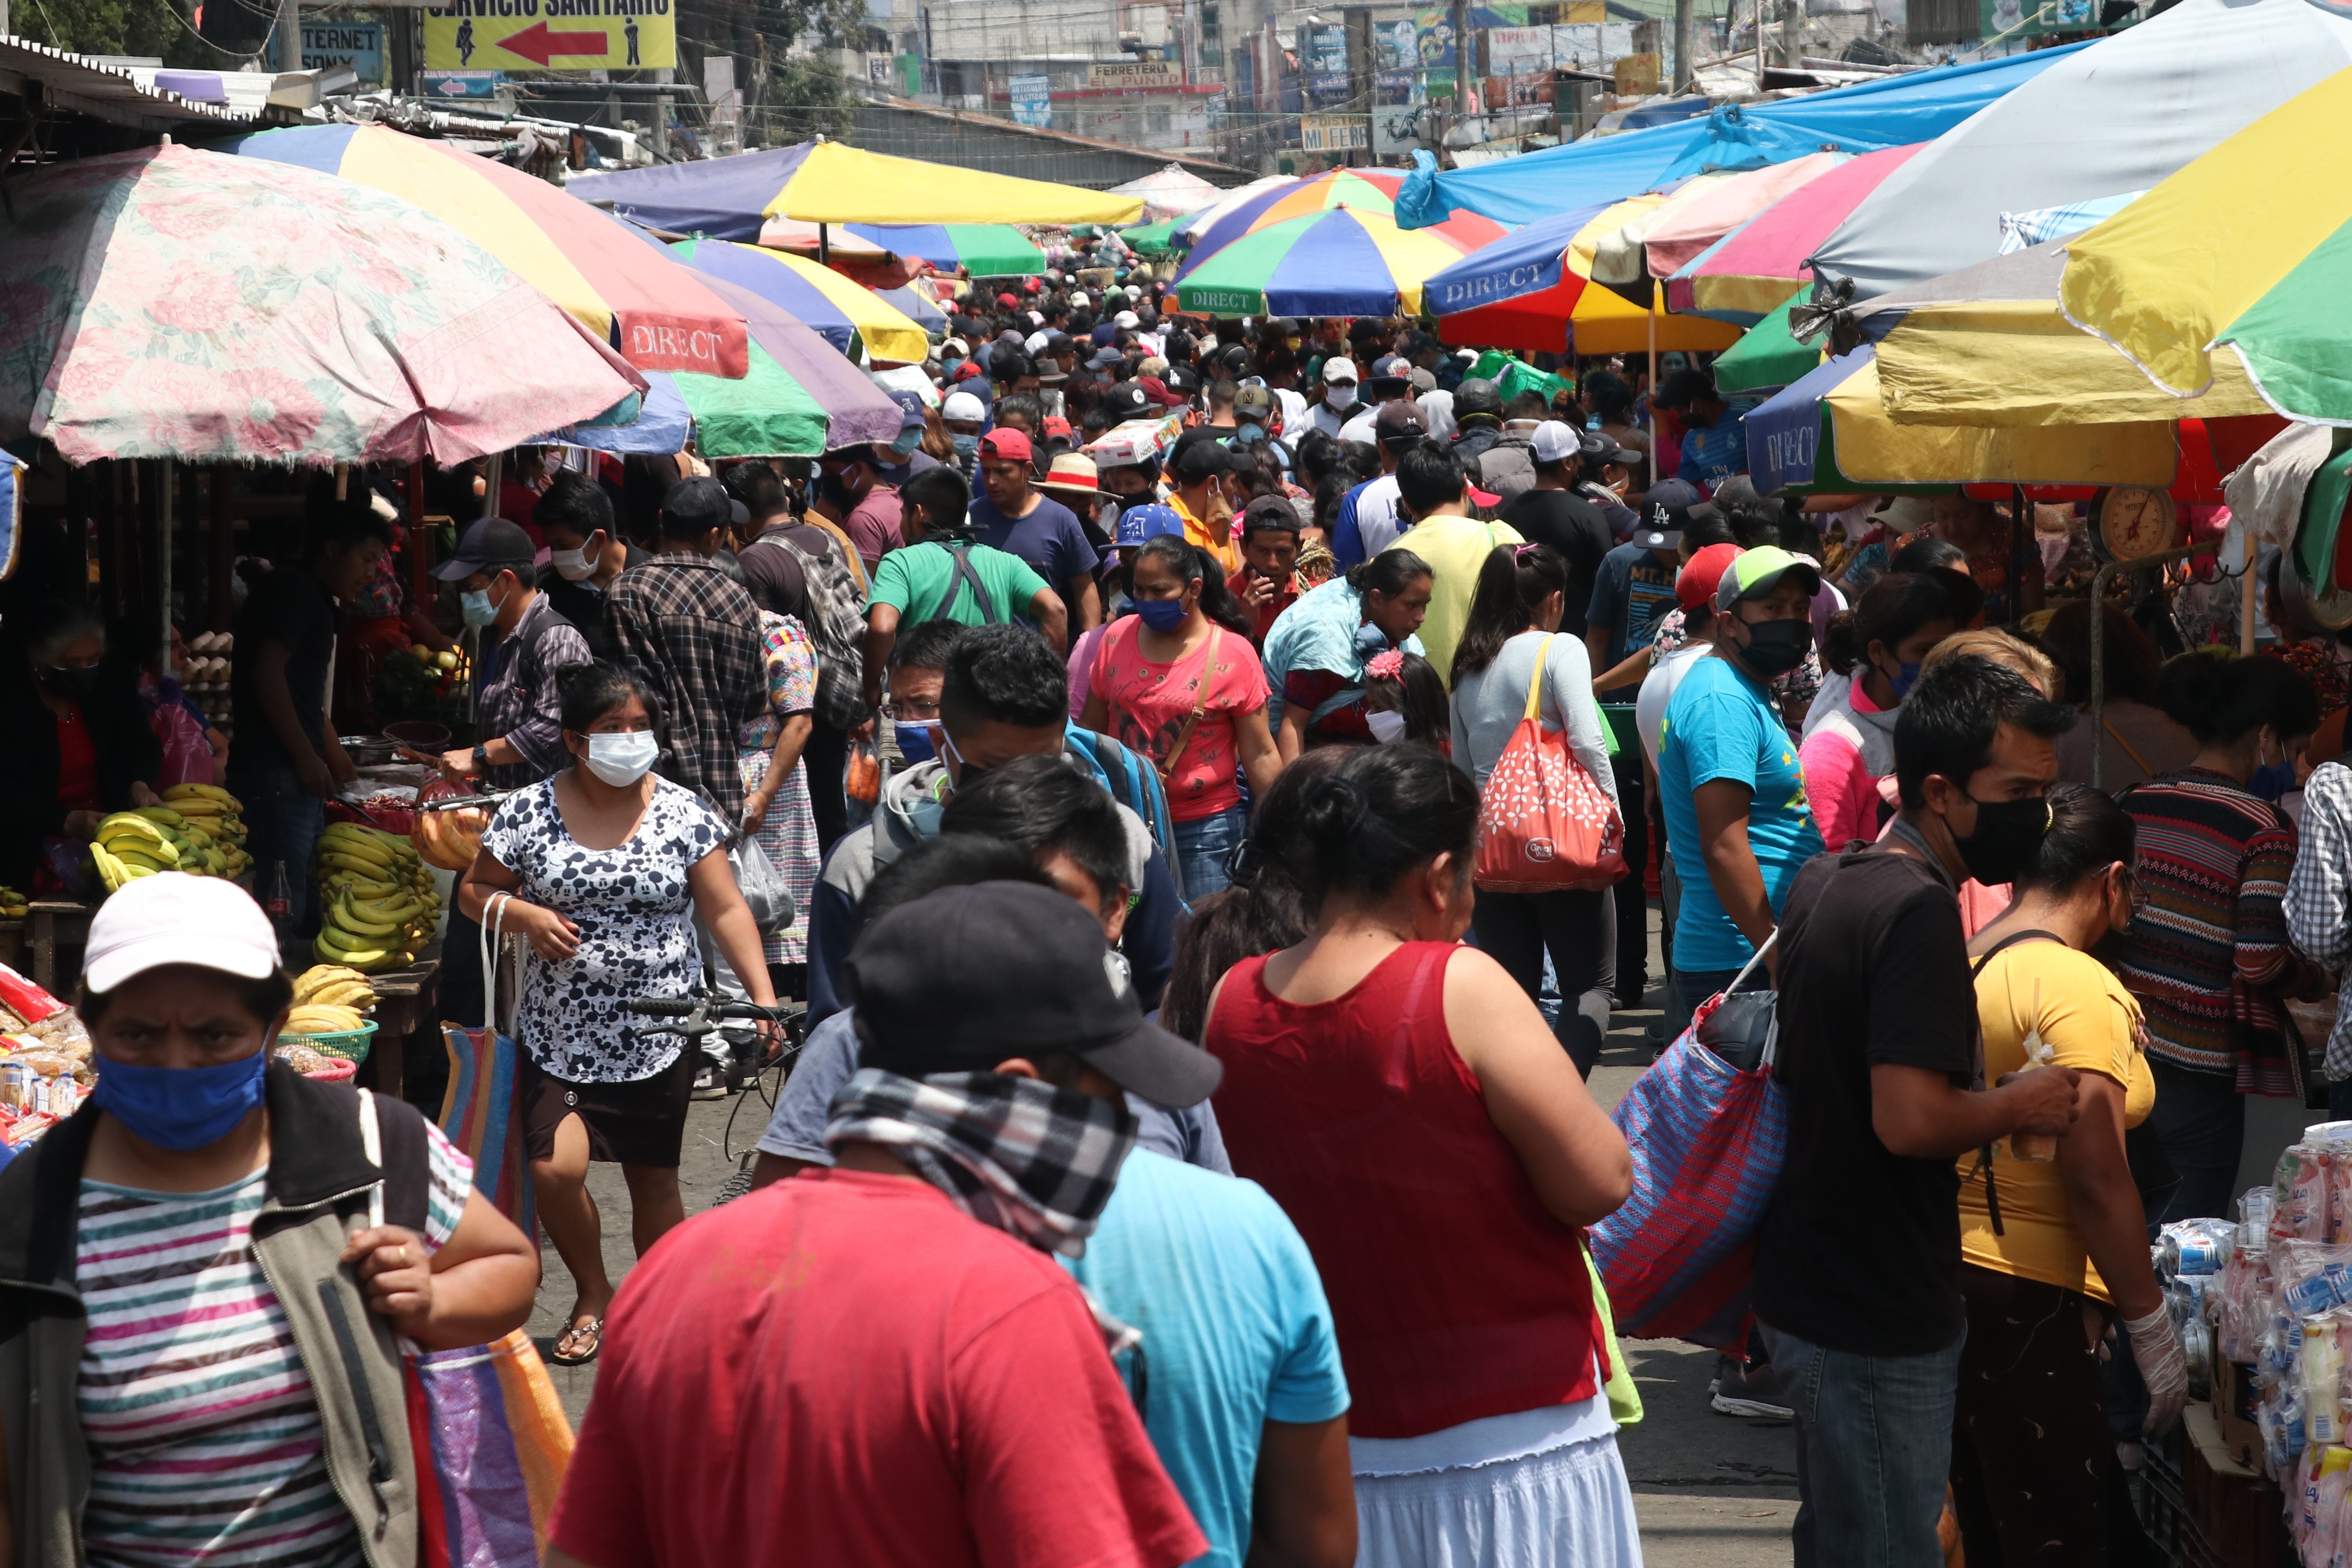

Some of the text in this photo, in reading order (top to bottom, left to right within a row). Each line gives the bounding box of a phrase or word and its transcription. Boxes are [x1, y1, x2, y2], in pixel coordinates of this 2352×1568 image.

[428, 0, 538, 17] RVICIO
[302, 29, 375, 50] TERNET
[1095, 64, 1169, 76] FERRETERIA
[1090, 75, 1178, 87] EL PUNTO
[1303, 129, 1322, 149] MI
[1447, 263, 1544, 303] DIRECT
[1193, 292, 1249, 308] DIRECT
[633, 325, 723, 363] DIRECT
[1169, 369, 1181, 385] LA
[1712, 465, 1728, 474] Fly
[1653, 503, 1670, 524] LA
[1530, 843, 1552, 853] Great
